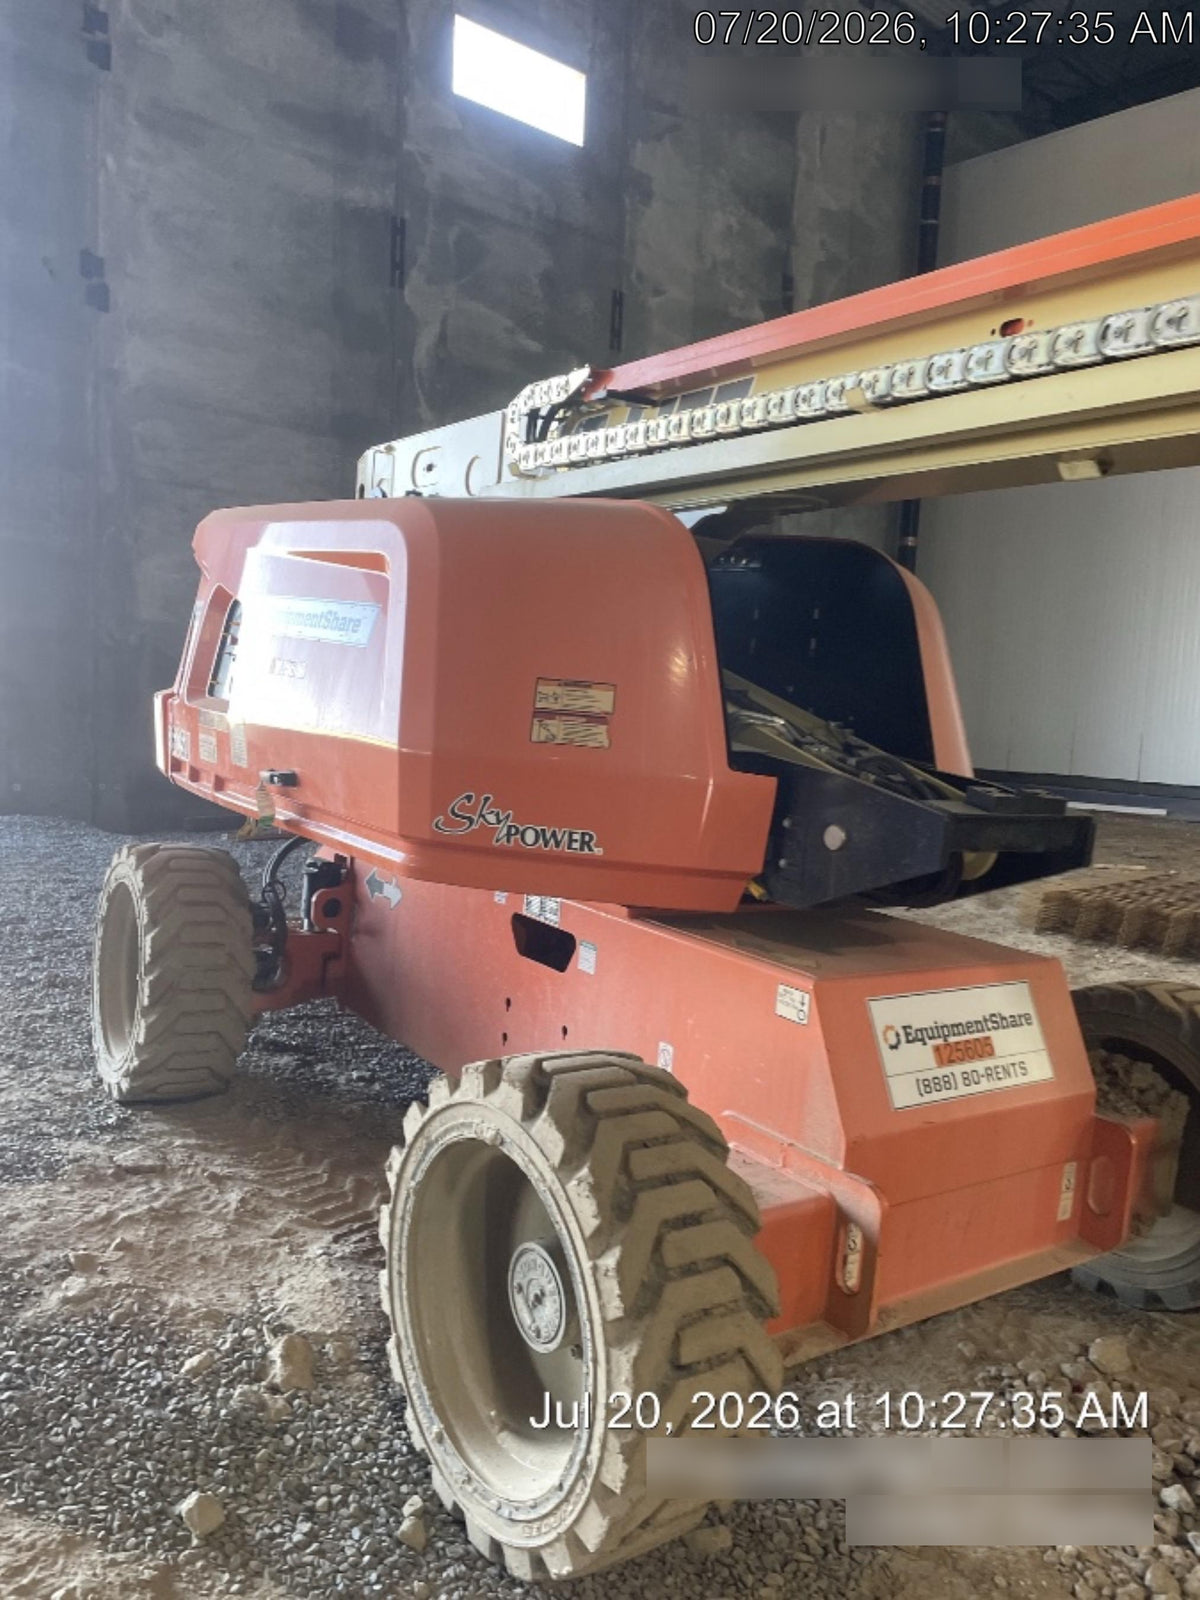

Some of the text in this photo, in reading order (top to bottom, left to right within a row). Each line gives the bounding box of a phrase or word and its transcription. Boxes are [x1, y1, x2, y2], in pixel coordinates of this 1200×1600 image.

[902, 1011, 1034, 1046] EquipmentShare
[936, 1037, 995, 1066] 125605
[916, 1060, 1029, 1097] (888) 80-RENTS
